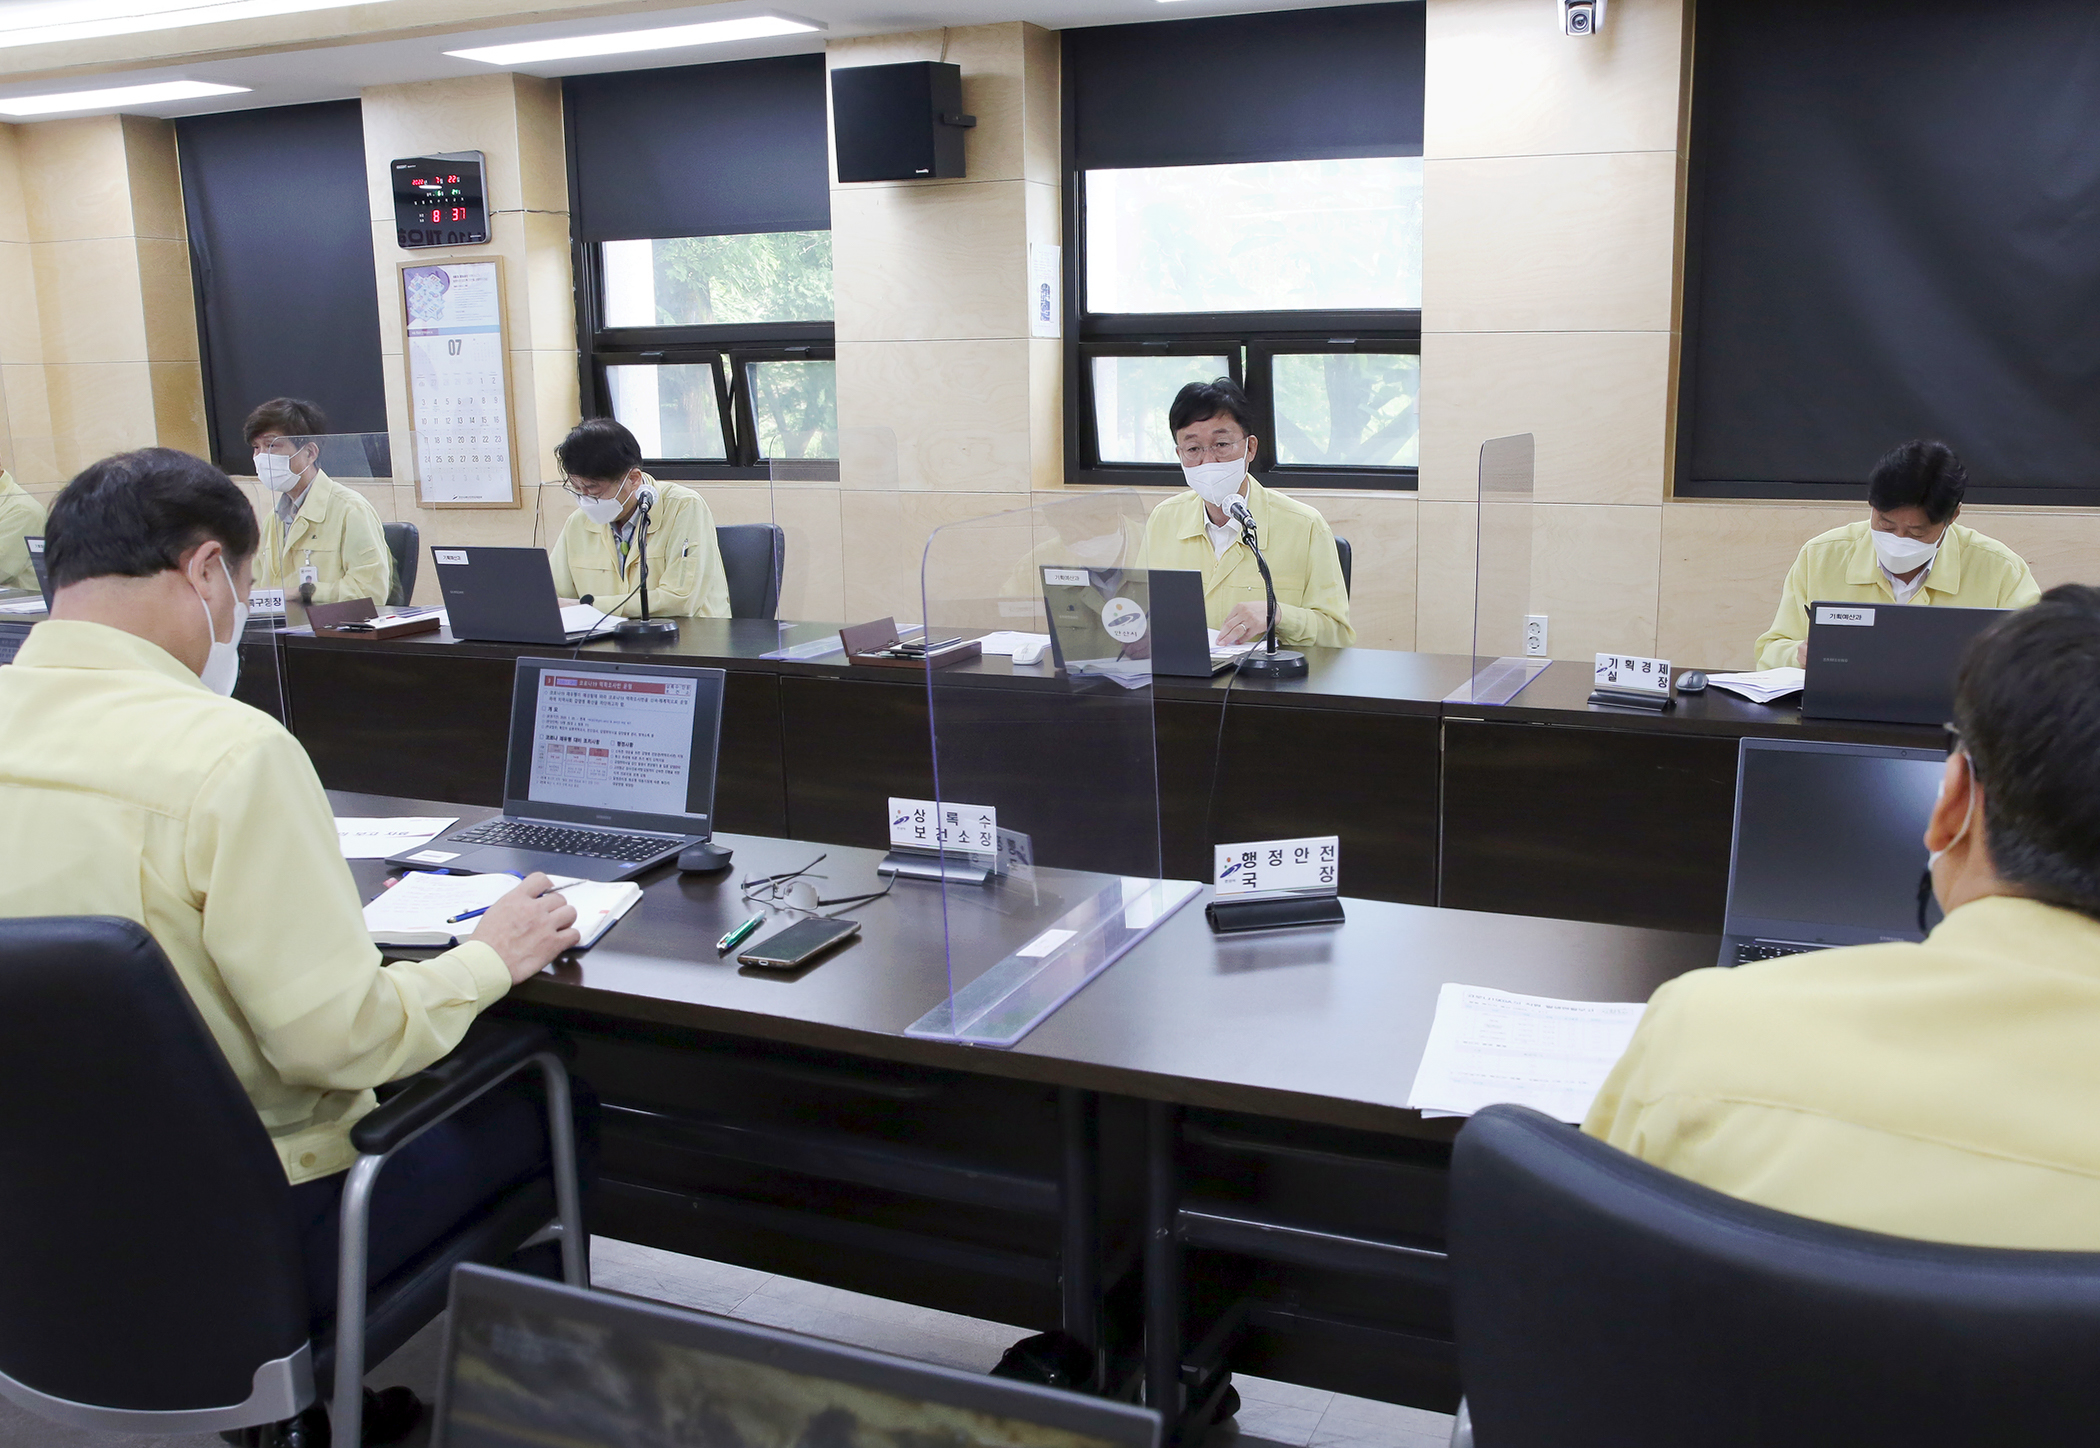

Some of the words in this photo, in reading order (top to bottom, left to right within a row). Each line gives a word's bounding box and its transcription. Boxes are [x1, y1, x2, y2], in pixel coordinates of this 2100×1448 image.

[448, 339, 462, 356] 07
[1829, 613, 1862, 621] 기획예산과
[1608, 658, 1668, 675] 기획경제
[1242, 845, 1334, 869] 행정안전
